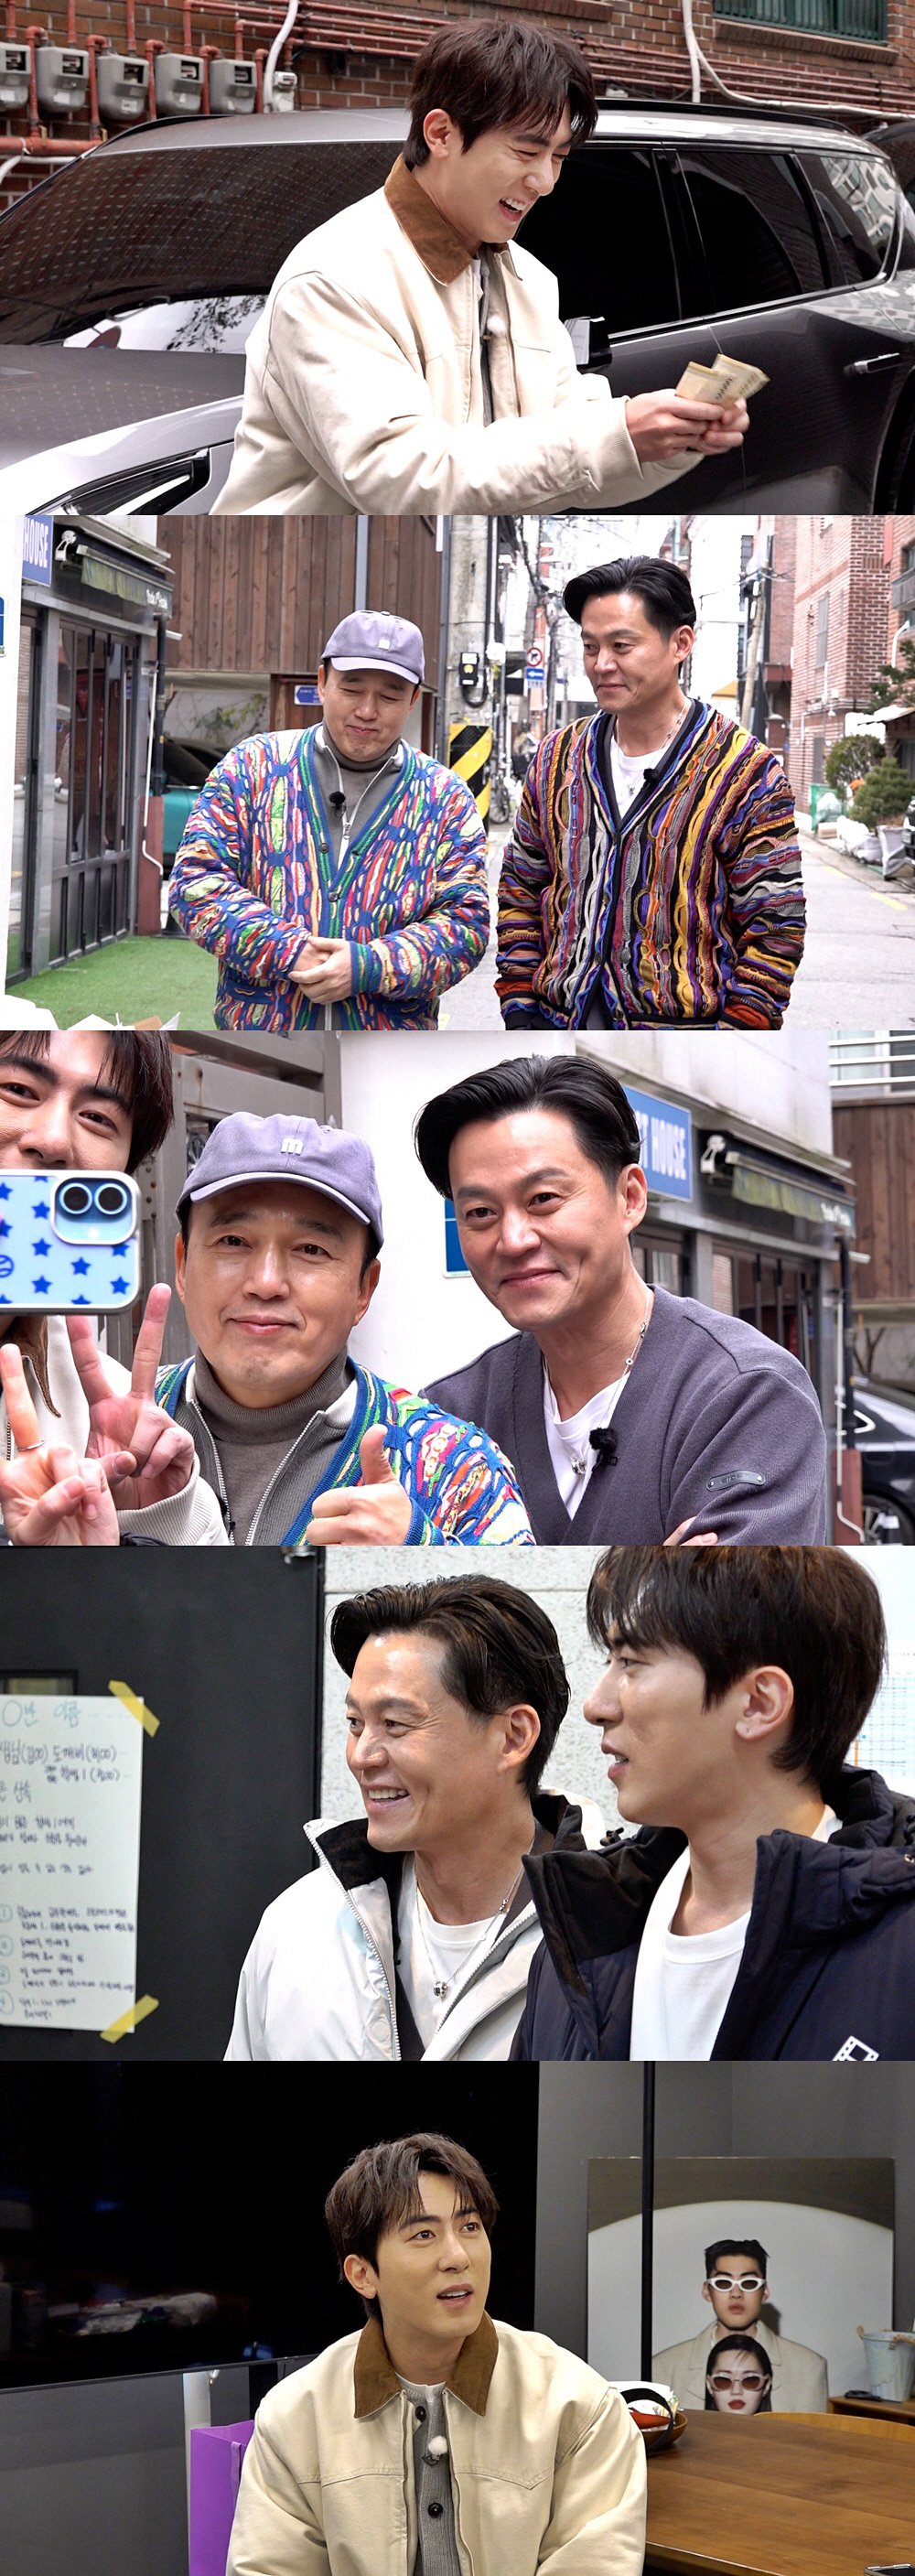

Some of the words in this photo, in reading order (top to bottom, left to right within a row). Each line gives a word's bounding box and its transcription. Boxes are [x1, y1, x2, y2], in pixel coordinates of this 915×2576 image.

[24, 516, 48, 568] HOUSE
[280, 1137, 304, 1156] m
[651, 1116, 686, 1180] HOUSE
